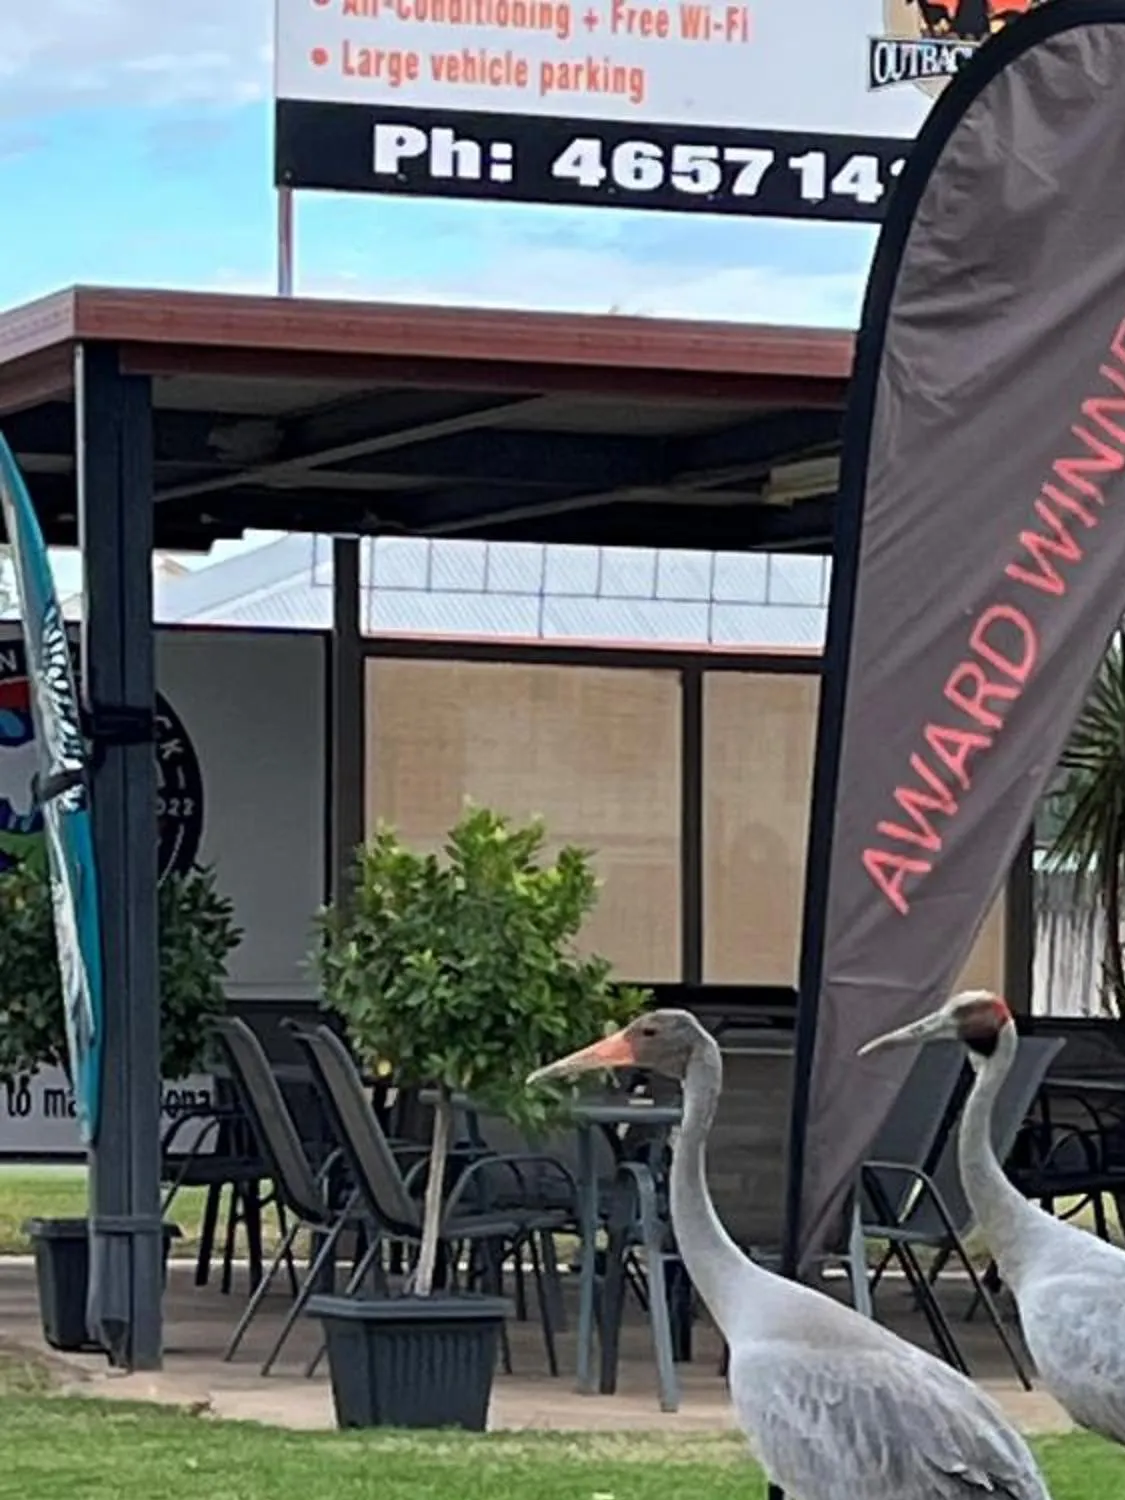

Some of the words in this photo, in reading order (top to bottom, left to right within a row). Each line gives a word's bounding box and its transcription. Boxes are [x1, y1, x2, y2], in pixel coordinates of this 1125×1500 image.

[583, 8, 598, 32] +
[611, 0, 669, 38] Free
[680, 4, 748, 42] Wi-Fi
[342, 39, 419, 88] Large
[430, 49, 528, 88] vehicle
[539, 56, 644, 104] parking
[874, 42, 973, 83] OUTBAC
[374, 124, 513, 181] Ph:
[552, 138, 774, 195] 4657
[789, 152, 906, 203] 14
[862, 604, 1039, 913] AWARD
[155, 798, 195, 816] 022
